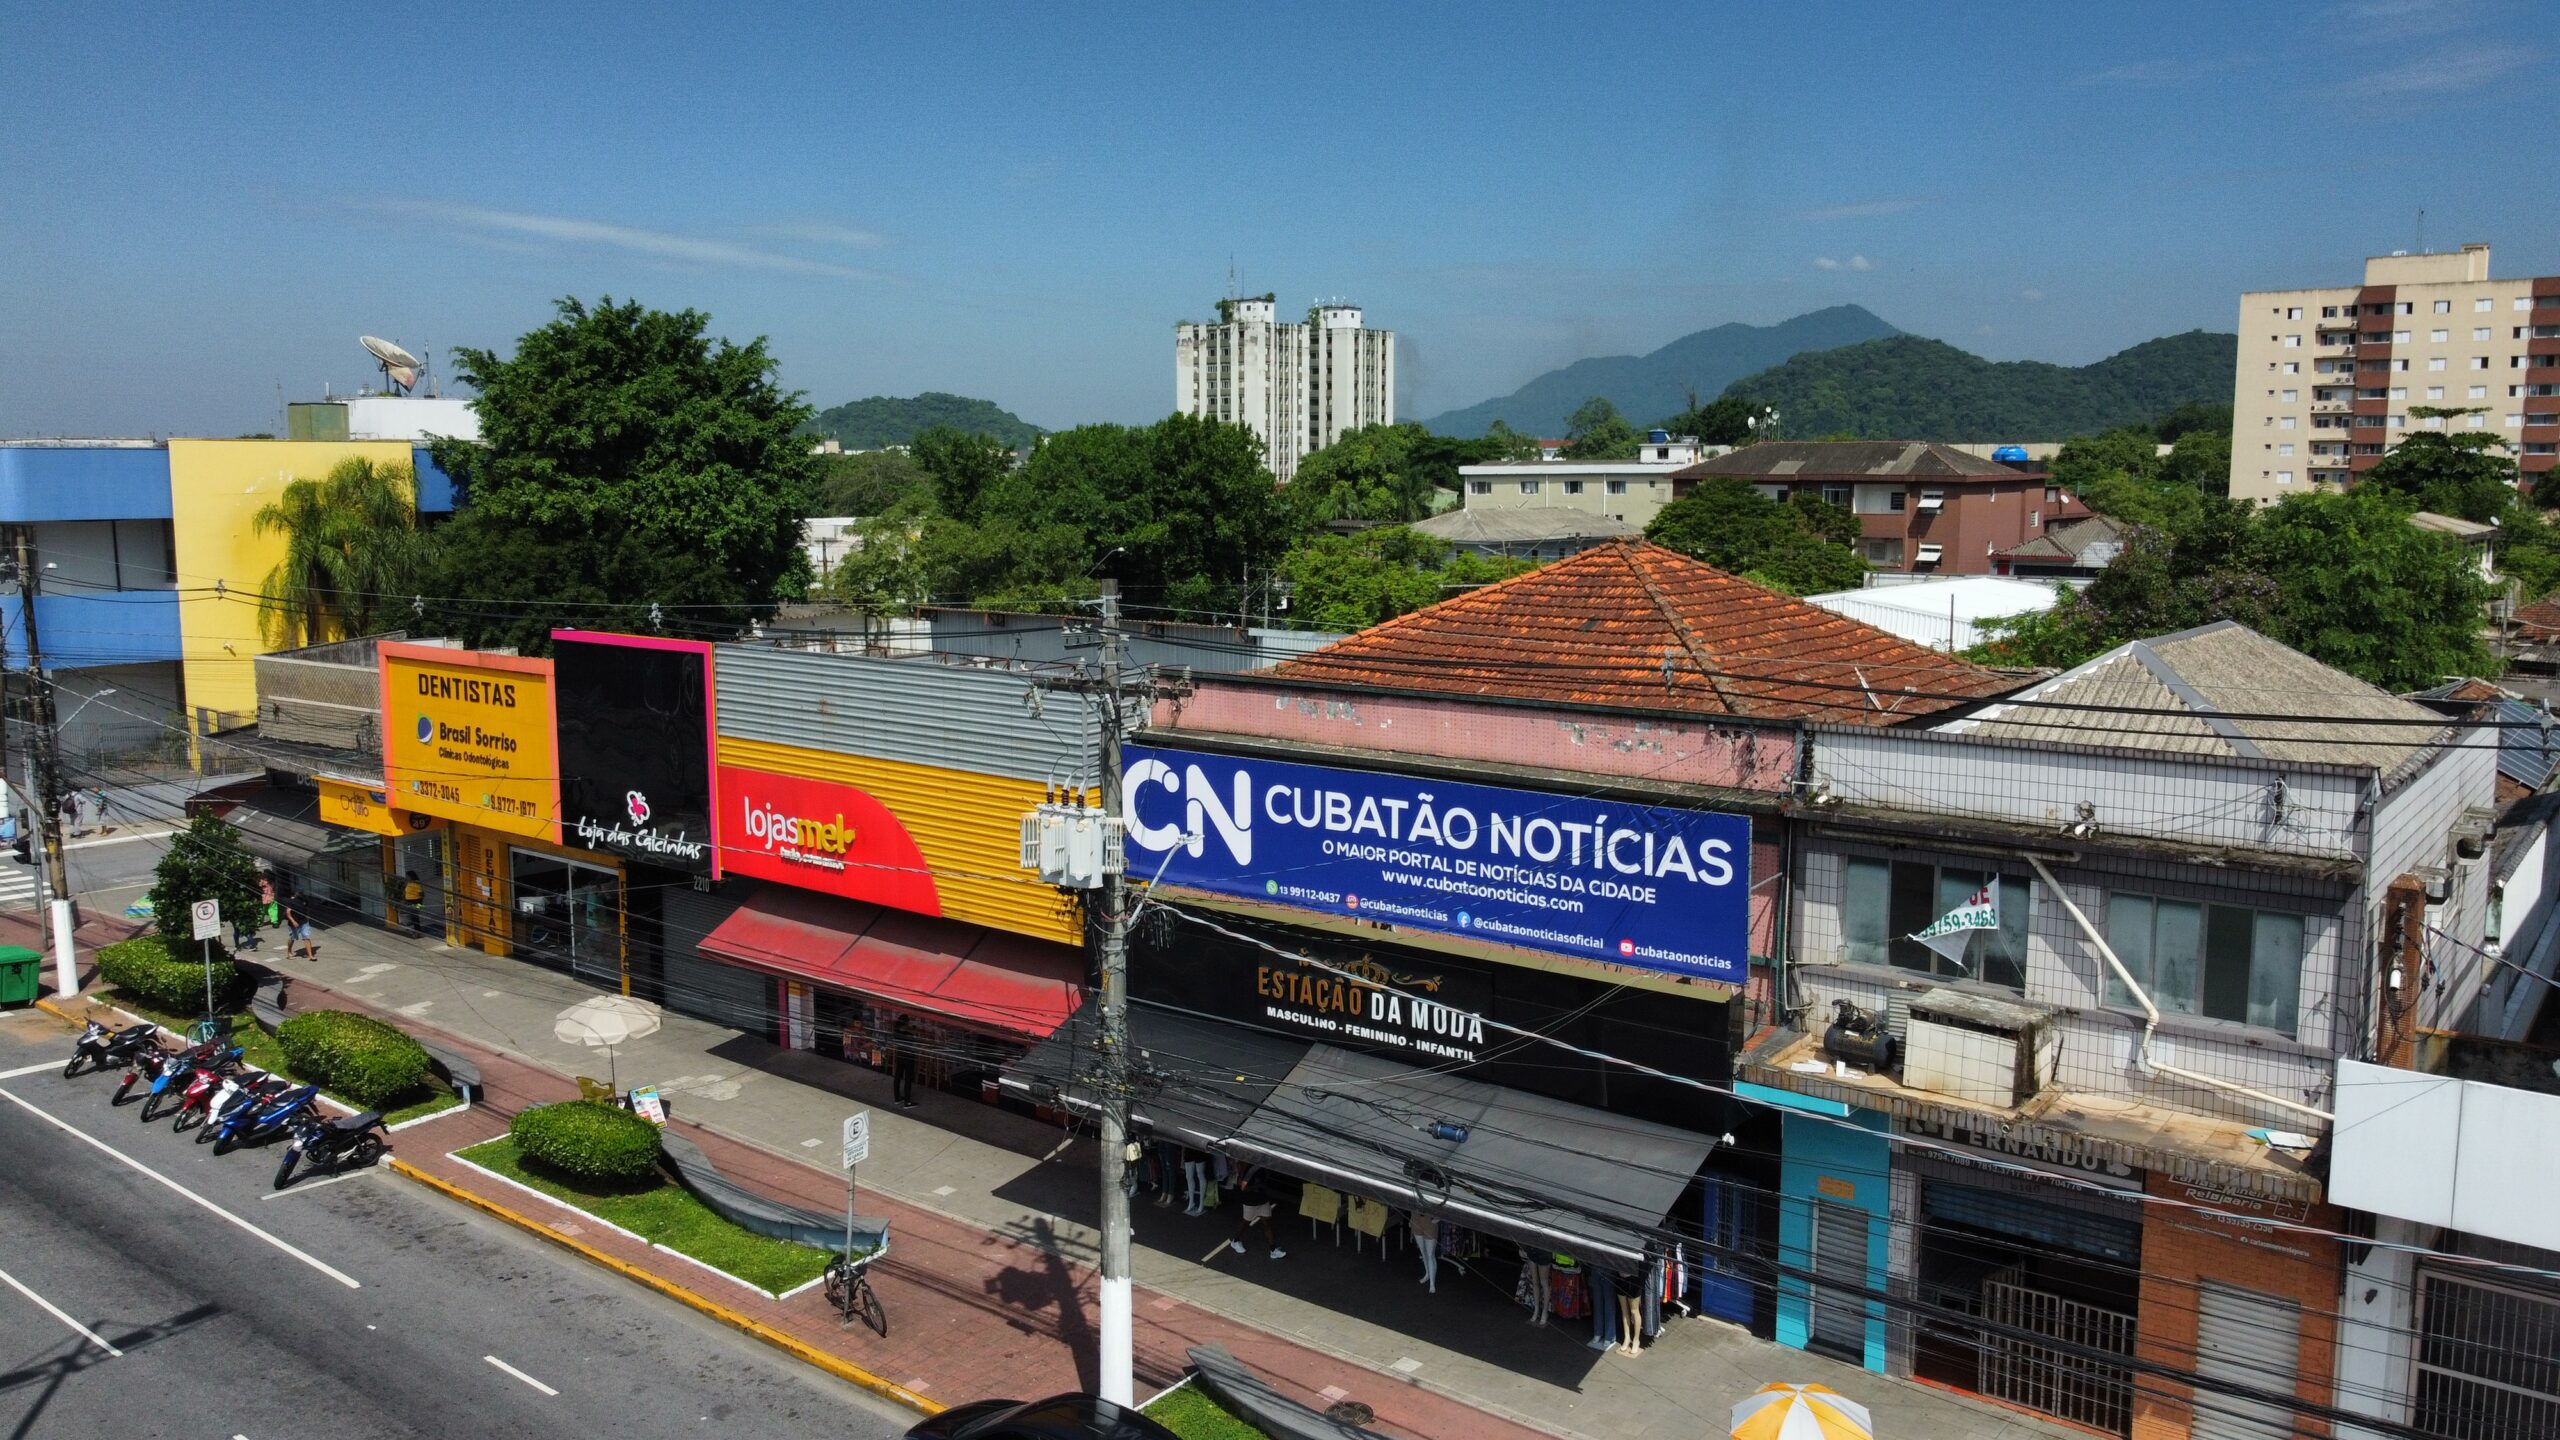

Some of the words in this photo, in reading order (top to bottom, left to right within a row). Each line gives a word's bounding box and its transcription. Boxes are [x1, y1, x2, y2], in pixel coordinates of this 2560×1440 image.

[418, 673, 517, 708] DENTISTAS
[439, 722, 471, 745] Brasil
[475, 727, 517, 752] Sorriso
[420, 780, 460, 802] 3372-3045
[1122, 757, 1252, 867] CN
[578, 815, 605, 849] Loja
[607, 822, 630, 846] das
[635, 828, 702, 860] Calcinhas
[1265, 784, 1478, 850] CUBATÃO
[1490, 812, 1734, 887] NOTÍCIAS
[693, 875, 710, 893] 2210
[1322, 839, 1335, 856] O
[1336, 841, 1387, 863] MAIOR
[1389, 849, 1452, 873] PORTAL
[1455, 858, 1477, 877] DE
[1480, 863, 1557, 889] NOTÍCIAS
[1560, 875, 1586, 894] DA
[1589, 879, 1657, 904] CIDADE
[1279, 885, 1289, 895] 13
[1289, 886, 1341, 904] 99112-0437
[1381, 869, 1584, 914] www.cubataonoticias.com
[1359, 897, 1449, 922] @cubataonoticias
[1473, 916, 1604, 949] @cubataonoticiasoficial
[1634, 944, 1732, 970] cubataonoticias
[1257, 966, 1363, 1016] ESTAÇÃO
[1371, 991, 1402, 1025] DA
[1411, 1000, 1484, 1044] MODA
[1266, 1005, 1337, 1031] MASCULINO
[1345, 1024, 1407, 1047] FEMININO
[1416, 1039, 1477, 1063] INFANTIL
